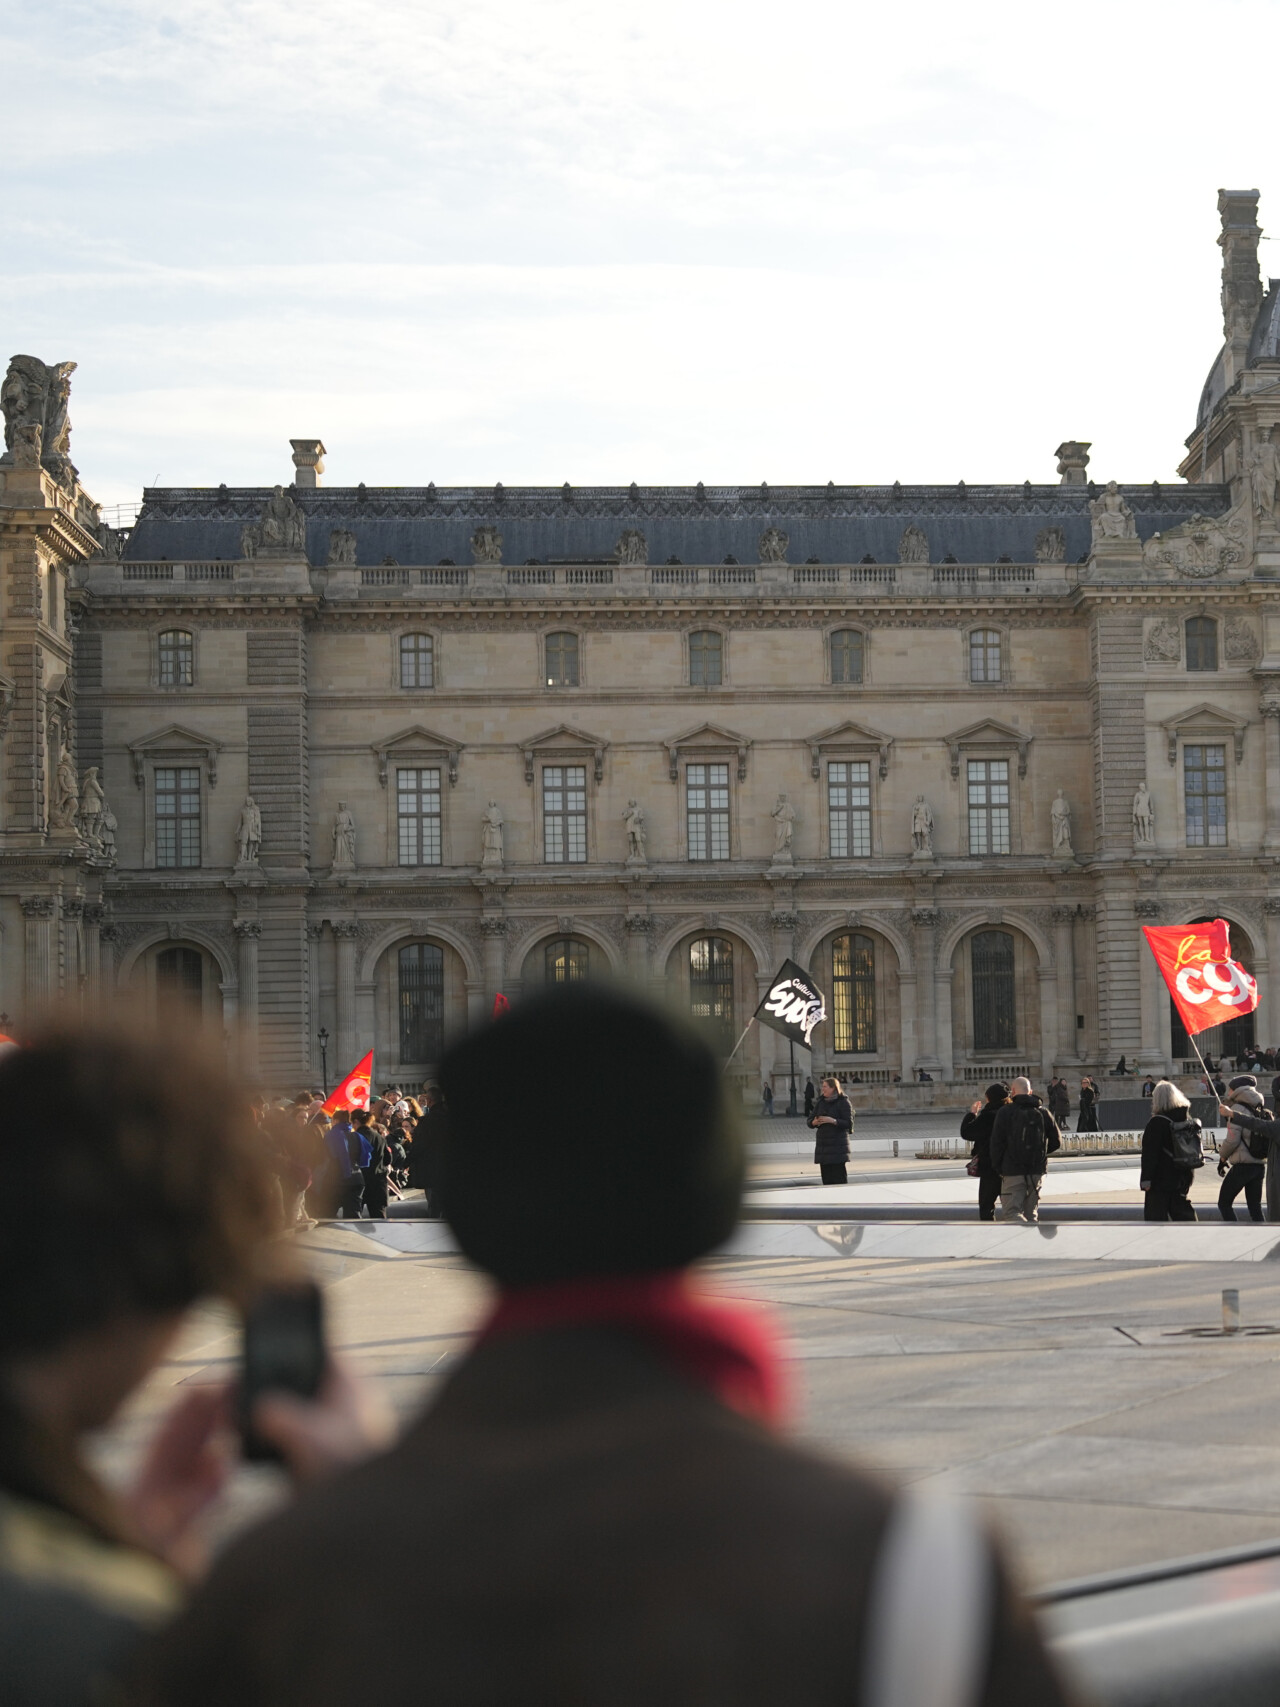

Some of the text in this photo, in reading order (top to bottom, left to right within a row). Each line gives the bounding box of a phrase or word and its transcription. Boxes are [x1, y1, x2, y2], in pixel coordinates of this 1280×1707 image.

[1174, 934, 1228, 970] la
[792, 978, 816, 1000] Culture
[1175, 959, 1256, 1006] cg
